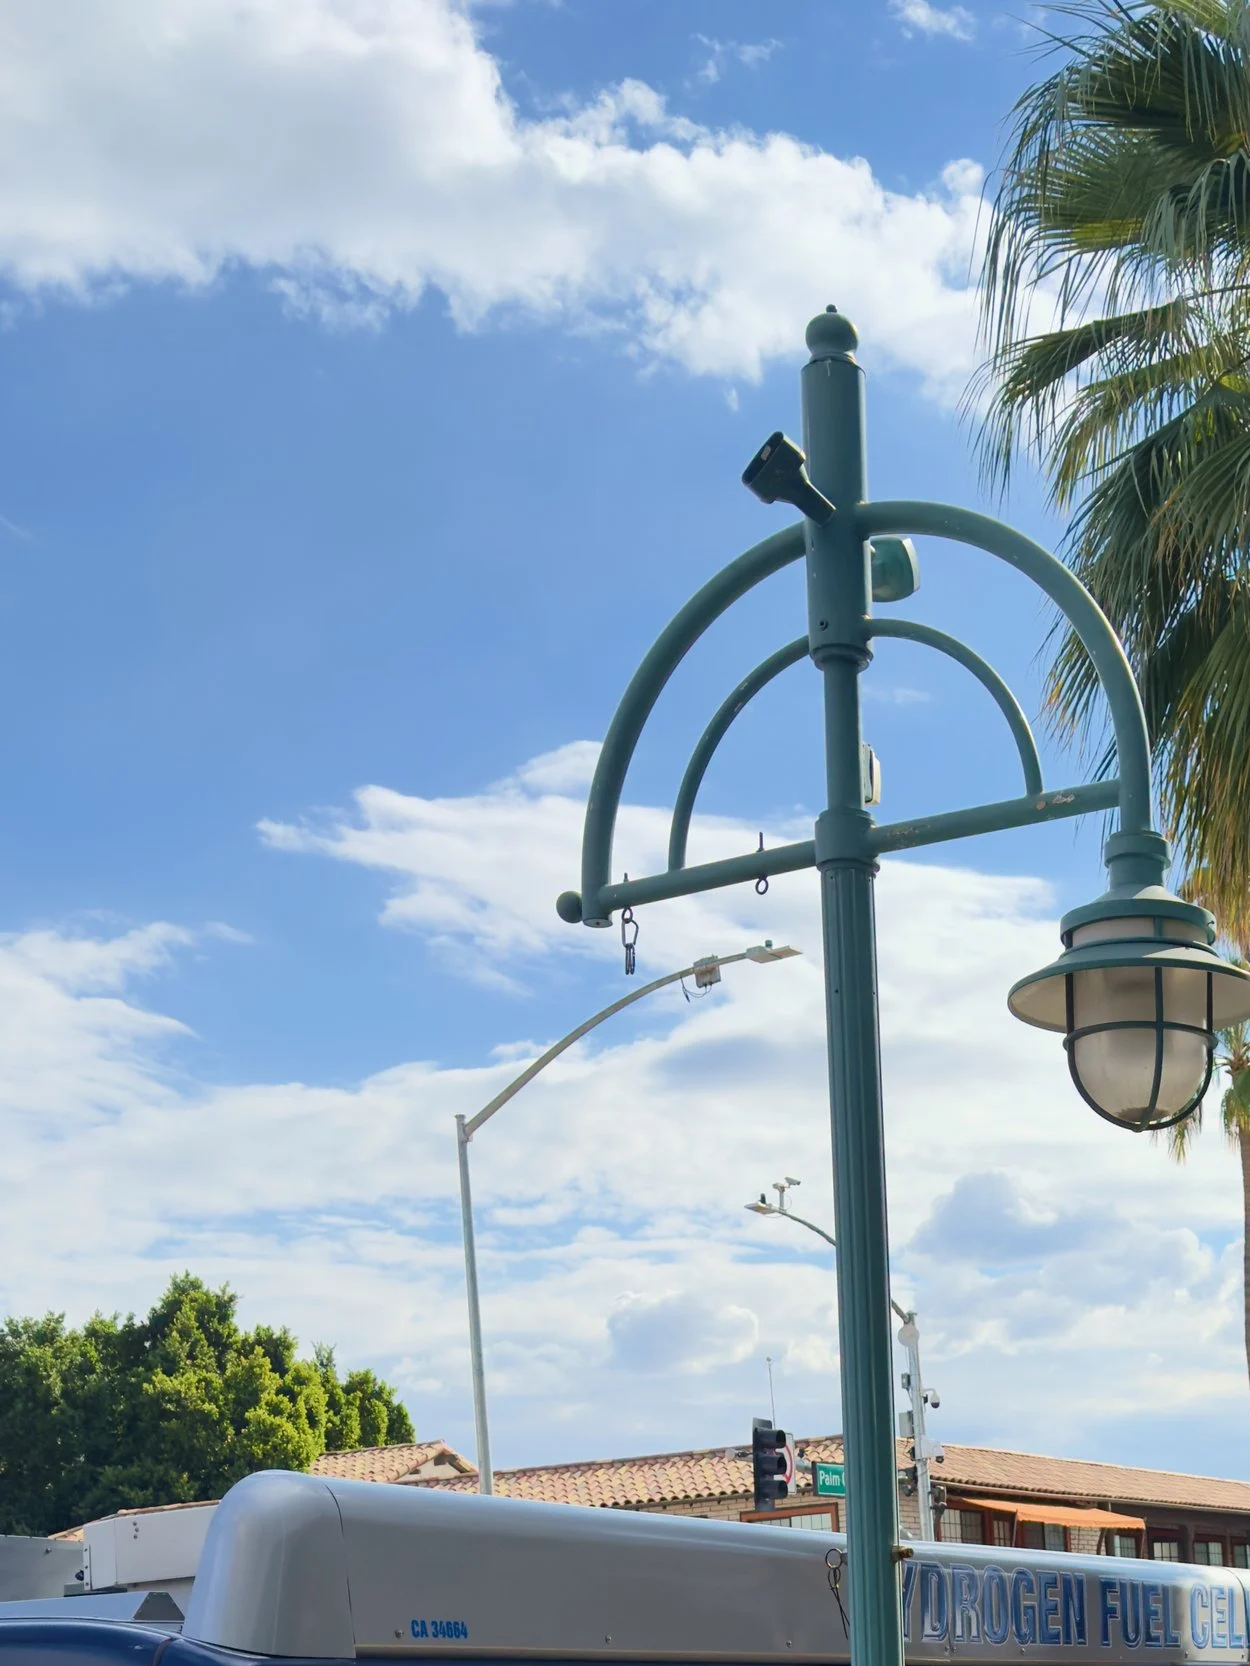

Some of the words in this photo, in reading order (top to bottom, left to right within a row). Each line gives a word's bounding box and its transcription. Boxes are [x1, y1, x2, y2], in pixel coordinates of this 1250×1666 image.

[819, 1471, 841, 1486] Palm
[903, 1560, 1088, 1647] YDROGEN
[1100, 1574, 1182, 1649] FUEL
[411, 1619, 428, 1638] CA
[431, 1620, 468, 1638] 34664
